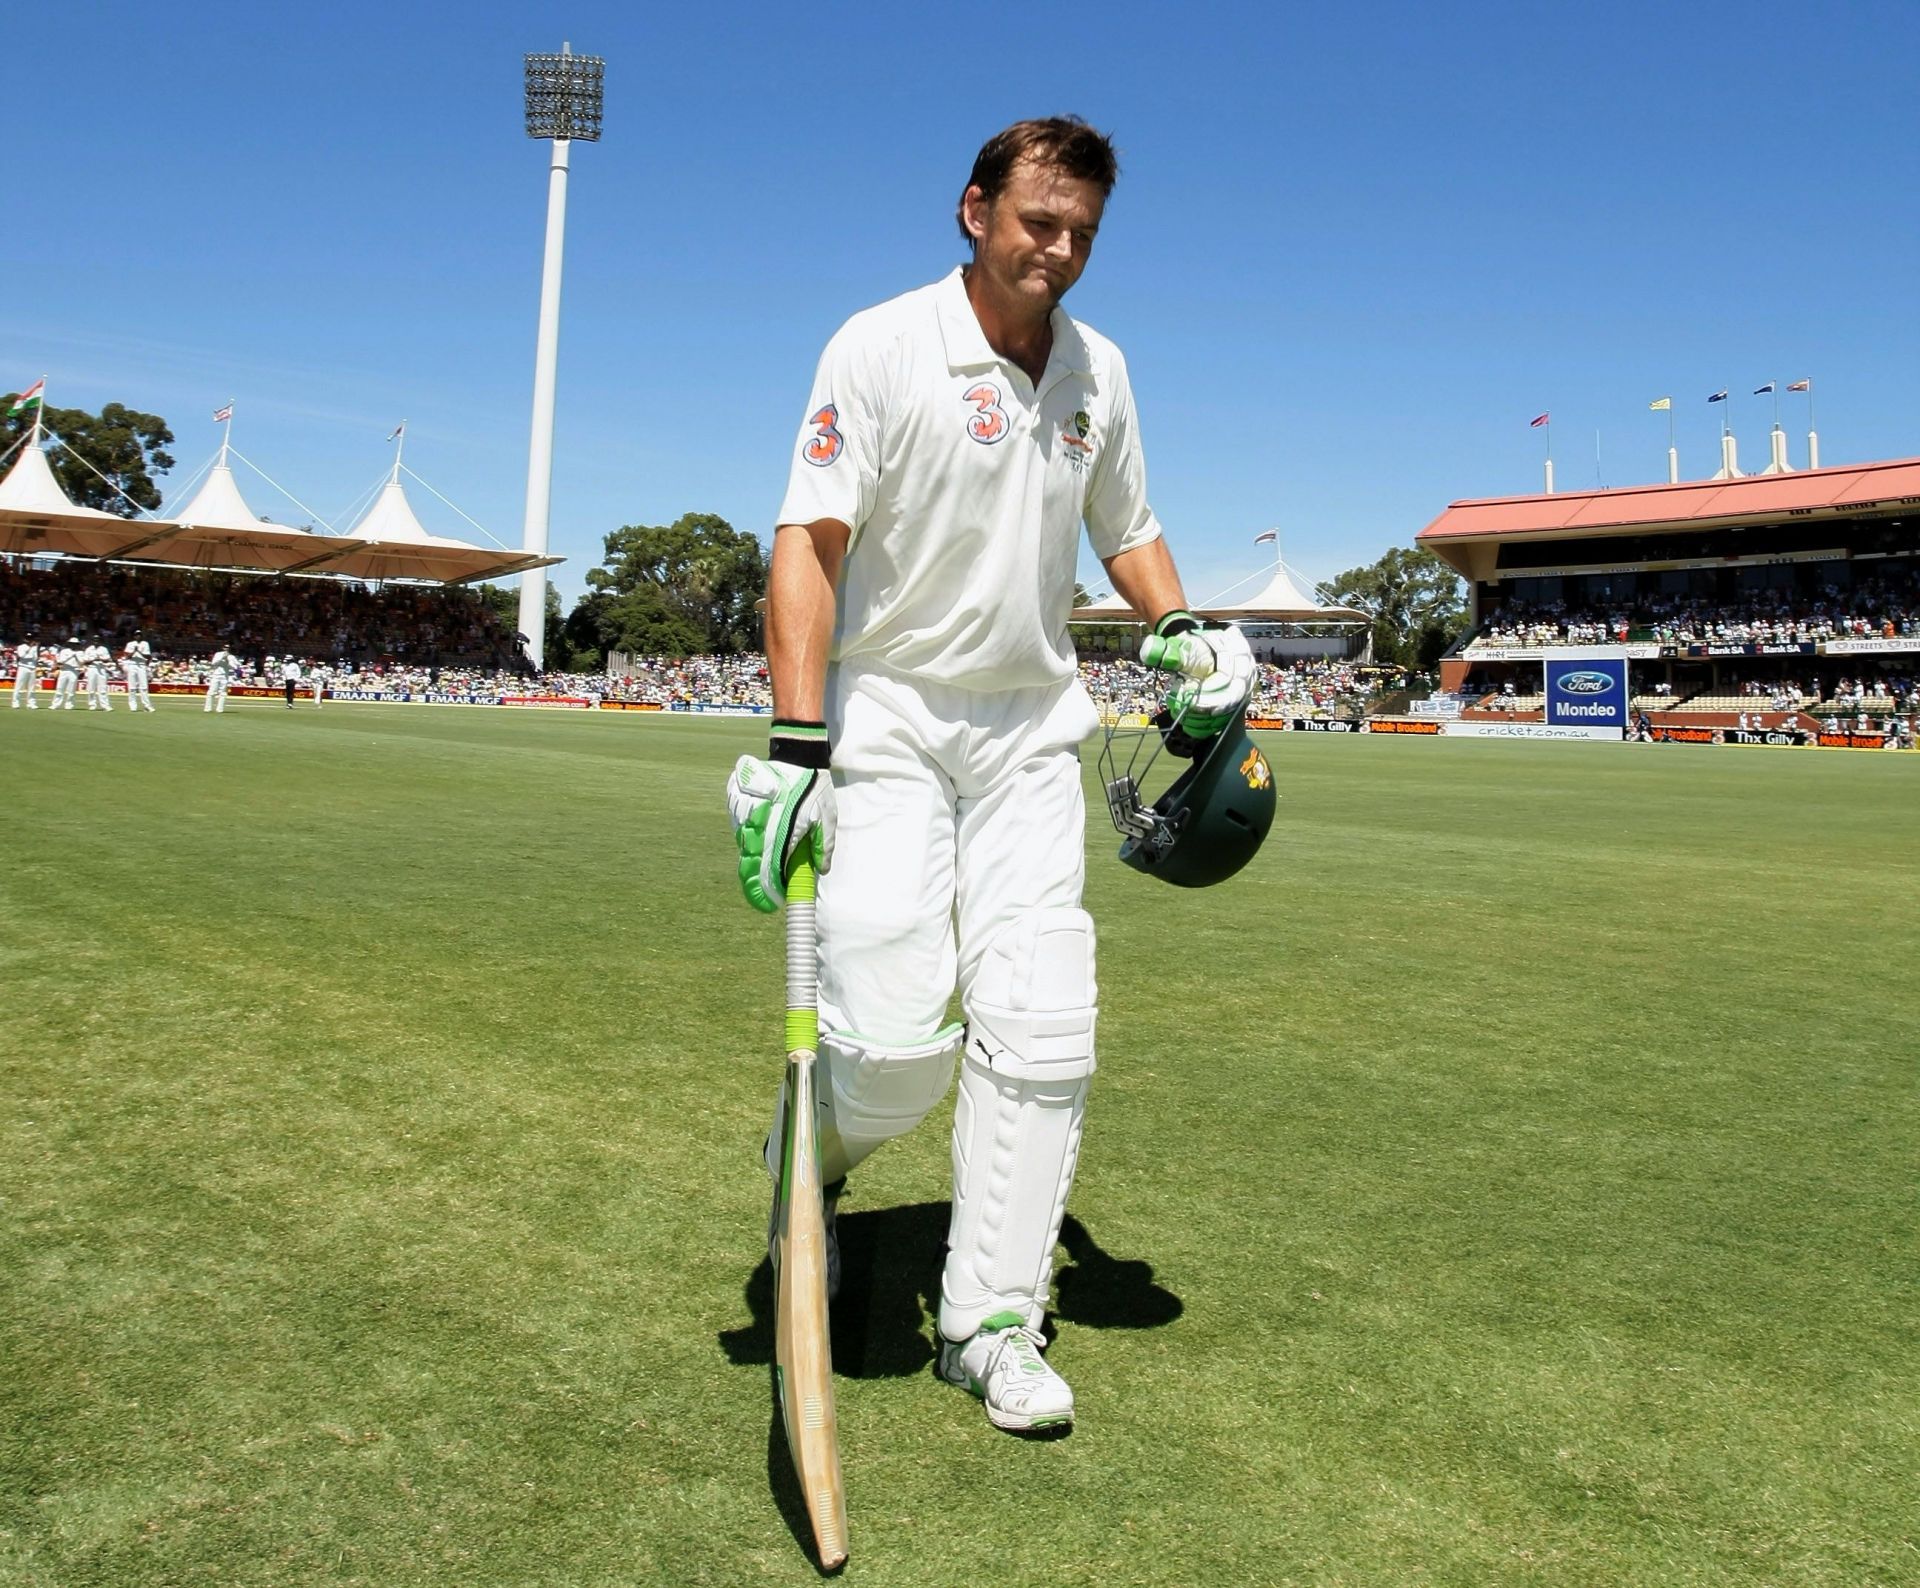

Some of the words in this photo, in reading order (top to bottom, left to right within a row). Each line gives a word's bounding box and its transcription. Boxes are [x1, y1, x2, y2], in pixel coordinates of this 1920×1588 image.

[1851, 642, 1884, 650] STREETS
[1568, 674, 1603, 690] Ford
[333, 691, 377, 701] EMAAR
[379, 692, 408, 701] MGF
[429, 696, 471, 704] EMAAR
[474, 697, 500, 705] MGF
[1556, 701, 1616, 716] Mondeo
[1303, 720, 1325, 731] Thx
[1328, 721, 1352, 733] Gilly
[1479, 725, 1590, 738] cricket.com.au
[1735, 731, 1762, 744] Thx
[1765, 732, 1795, 746] Gilly
